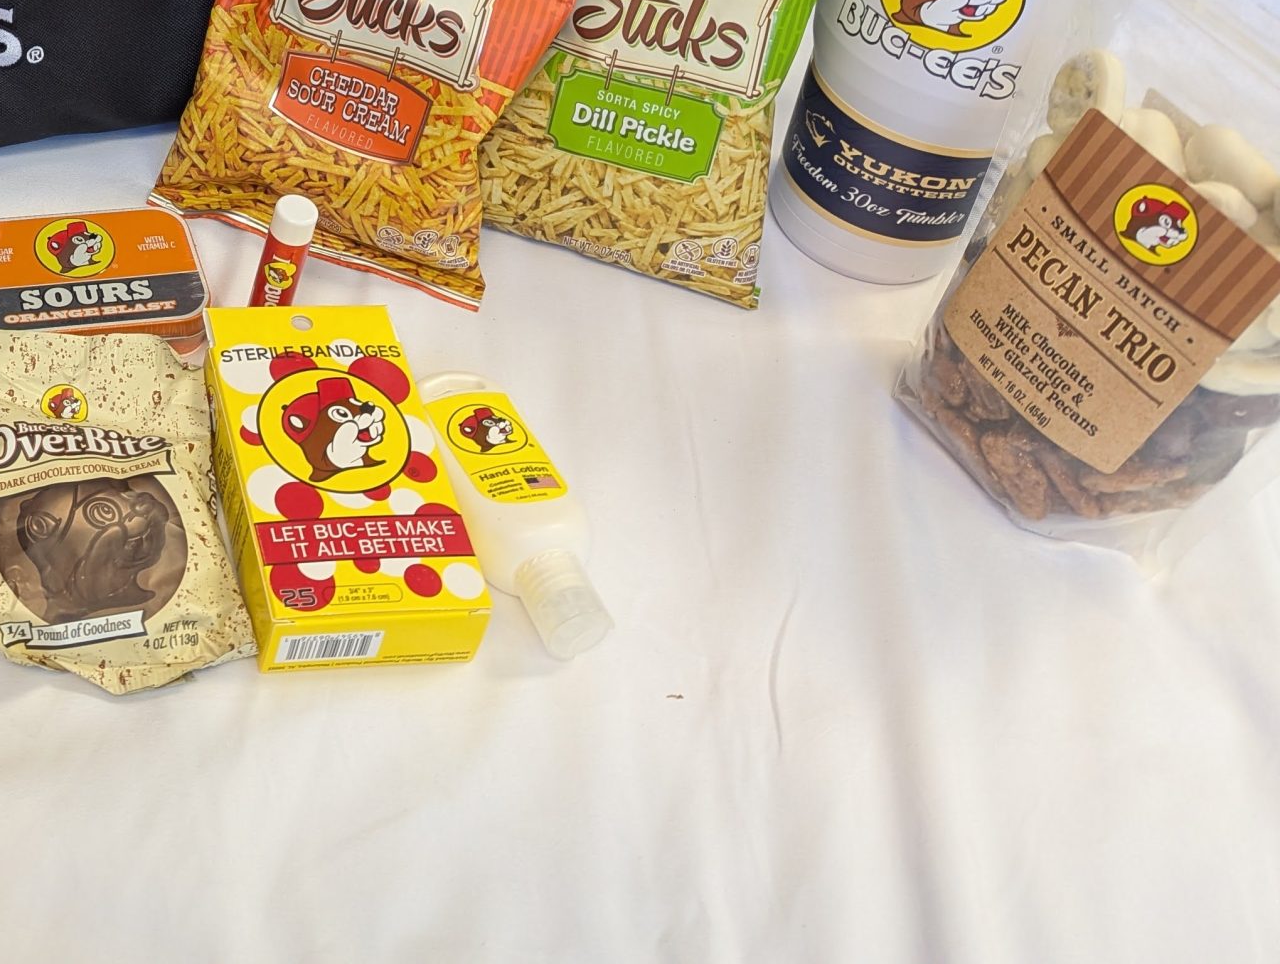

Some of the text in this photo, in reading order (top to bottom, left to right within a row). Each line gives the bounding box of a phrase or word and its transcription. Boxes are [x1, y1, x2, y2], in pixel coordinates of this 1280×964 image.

[309, 66, 399, 116] CHEDDAR
[597, 90, 681, 120] SORTA SPICY
[286, 79, 411, 145] SOUR CREAM
[572, 102, 697, 154] Dill Pickle
[306, 115, 374, 150] FLAVORED
[587, 136, 664, 167] FLAVORED
[839, 139, 977, 191] YUKON
[791, 133, 966, 226] Freedom 30oz Tumbler
[833, 154, 969, 201] OUTFITTERS
[137, 241, 177, 252] VITAMIN C
[144, 236, 165, 244] WITH
[1051, 214, 1183, 335] SMALL BATCH
[3, 299, 177, 325] ORANGE BLAST
[20, 279, 154, 312] SOURS
[1006, 223, 1178, 385] PECAN TRIO
[220, 344, 402, 364] STERILE BANDAGES
[994, 315, 1086, 408] White Fudge &
[1002, 302, 1097, 398] Milk Chocolate,
[970, 309, 1099, 437] Honey Glazed Pecans
[979, 354, 993, 374] NET
[1005, 379, 1016, 393] 16
[1026, 401, 1051, 429] (454g)
[18, 422, 79, 434] Buc-ee's
[0, 473, 26, 492] DARK
[26, 464, 82, 487] CHOCOLATE
[82, 462, 120, 477] COOKIES
[129, 458, 162, 474] CREAM
[479, 468, 510, 482] Hand
[511, 464, 549, 474] Lotion
[270, 519, 456, 543] LET BUC-EE MAKE
[291, 536, 446, 559] IT ALL BETTER!
[280, 589, 318, 609] 25
[37, 618, 133, 643] Pound of Goodness
[142, 639, 151, 649] 4
[169, 632, 199, 649] (113g)
[162, 620, 181, 634] NET
